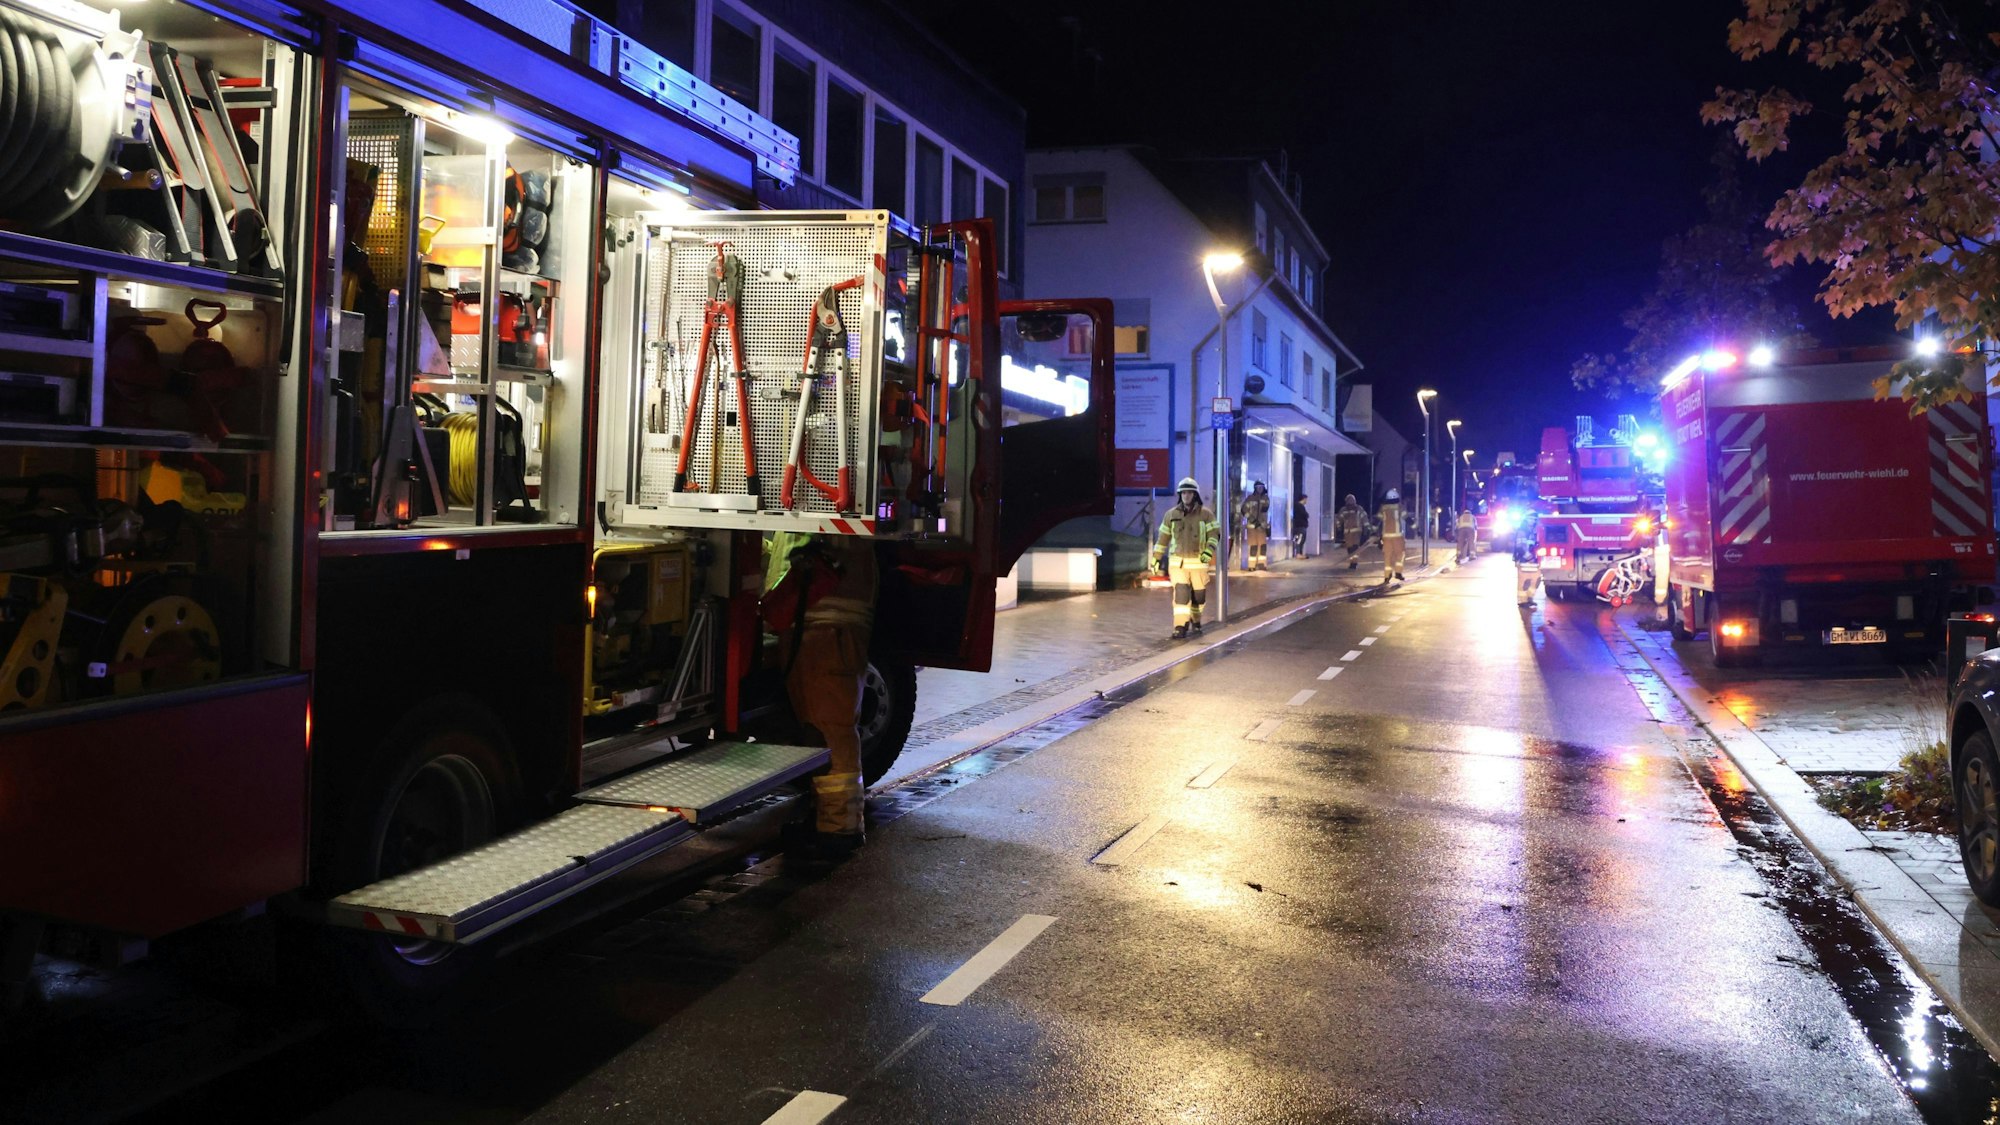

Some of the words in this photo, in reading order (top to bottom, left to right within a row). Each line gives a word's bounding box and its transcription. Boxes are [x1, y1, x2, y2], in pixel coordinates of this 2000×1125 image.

[1789, 467, 1909, 481] www.feuerwehr-wiehl.de
[1831, 632, 1843, 642] GM
[1861, 631, 1884, 641] 8069
